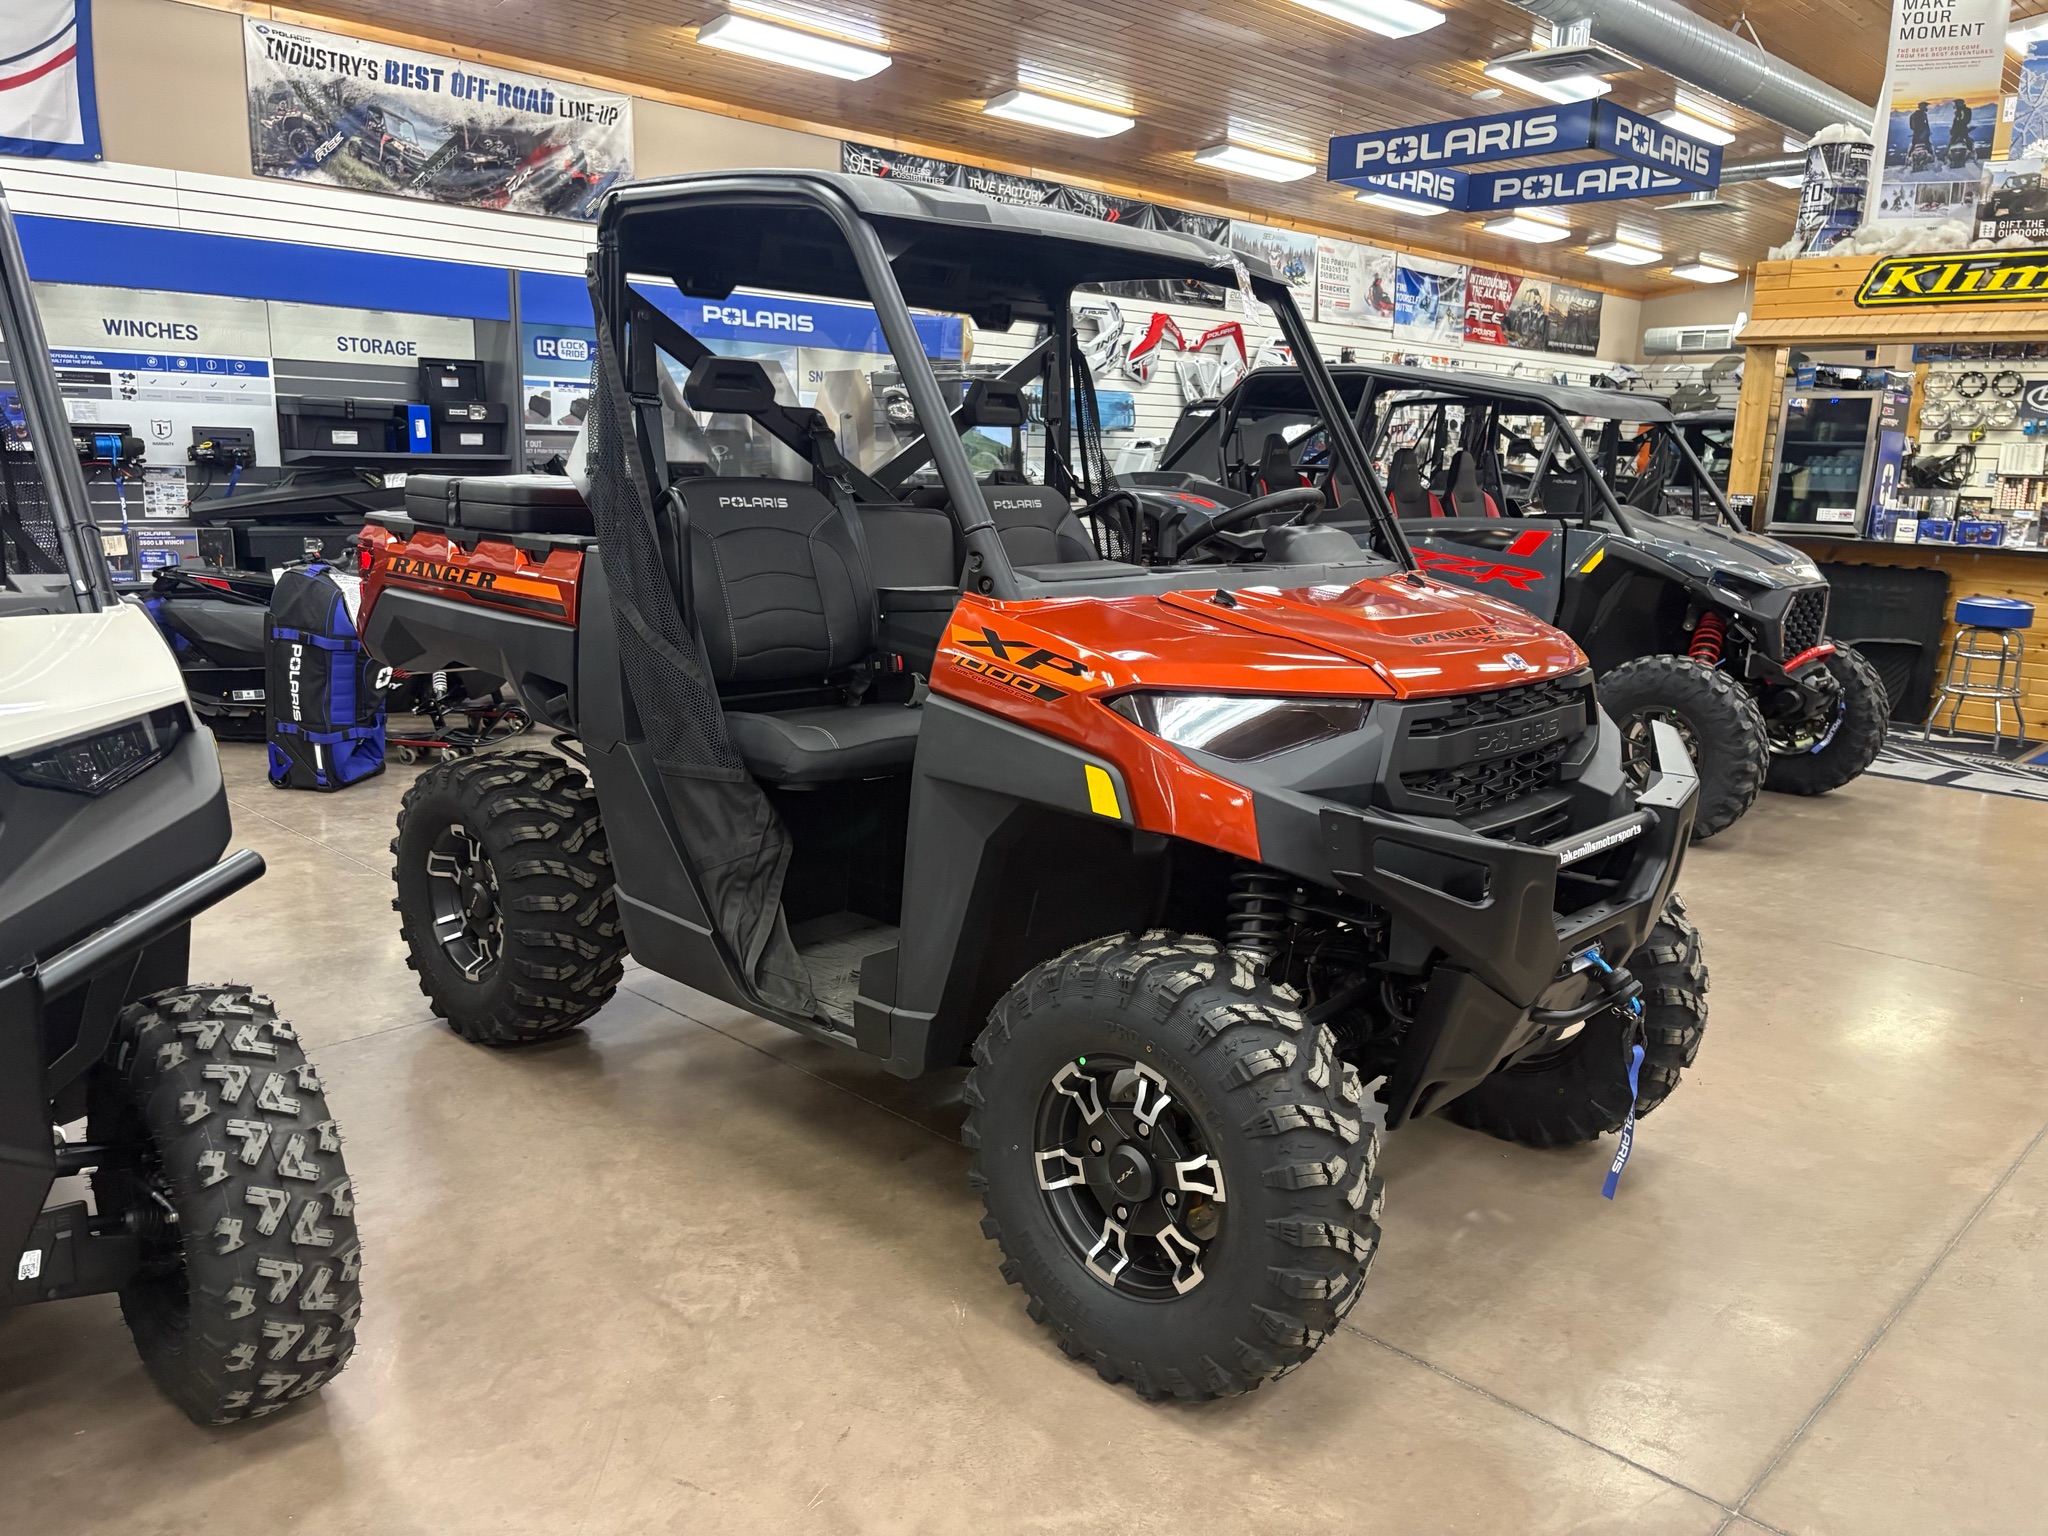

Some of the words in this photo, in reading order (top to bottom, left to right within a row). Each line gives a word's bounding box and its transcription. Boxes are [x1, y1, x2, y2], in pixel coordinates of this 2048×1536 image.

[1903, 0, 1956, 10] MAKE
[1902, 10, 1951, 25] YOUR
[271, 28, 312, 43] POLARIS
[1900, 22, 1985, 40] MOMENT
[266, 37, 378, 80] INDUSTRY'S
[385, 60, 444, 92] BEST
[451, 70, 554, 115] OFF-ROAD
[559, 98, 618, 126] LINE-UP
[1355, 114, 1557, 169] POLARIS
[1614, 115, 1710, 176] POLARIS
[849, 153, 880, 177] SEE
[892, 163, 931, 176] LIMITLESS
[891, 170, 945, 185] POSSIBILITIES
[1367, 170, 1455, 202] OLARIS
[1493, 163, 1682, 203] POLARIS
[968, 176, 996, 193] TRUE
[998, 182, 1046, 202] FACTORY
[1998, 228, 2048, 238] OUTDOORS
[1999, 221, 2023, 229] GIFT
[2025, 219, 2046, 228] THE
[1469, 272, 1509, 291] INTRODUCING
[1871, 262, 2048, 297] Klim
[1556, 294, 1597, 308] RANGER
[702, 305, 814, 332] POLARIS
[1465, 308, 1504, 325] ACE
[102, 318, 199, 341] WINCHES
[1207, 326, 1236, 340] POLARIS
[336, 336, 418, 356] STORAGE
[560, 341, 585, 351] LOCK
[561, 349, 586, 359] &RIDE
[719, 496, 788, 508] POLARIS
[994, 499, 1042, 510] POLARIS
[392, 557, 497, 589] RANGER
[1410, 625, 1509, 645] RANGER
[957, 626, 1089, 677] XP
[289, 644, 303, 721] POLARIS
[950, 654, 1041, 694] 1000
[1474, 719, 1560, 757] POLARIS
[1559, 824, 1642, 865] lakemillsmotorsports
[1610, 1108, 1635, 1174] OLARIS
[1116, 1166, 1135, 1184] XP
